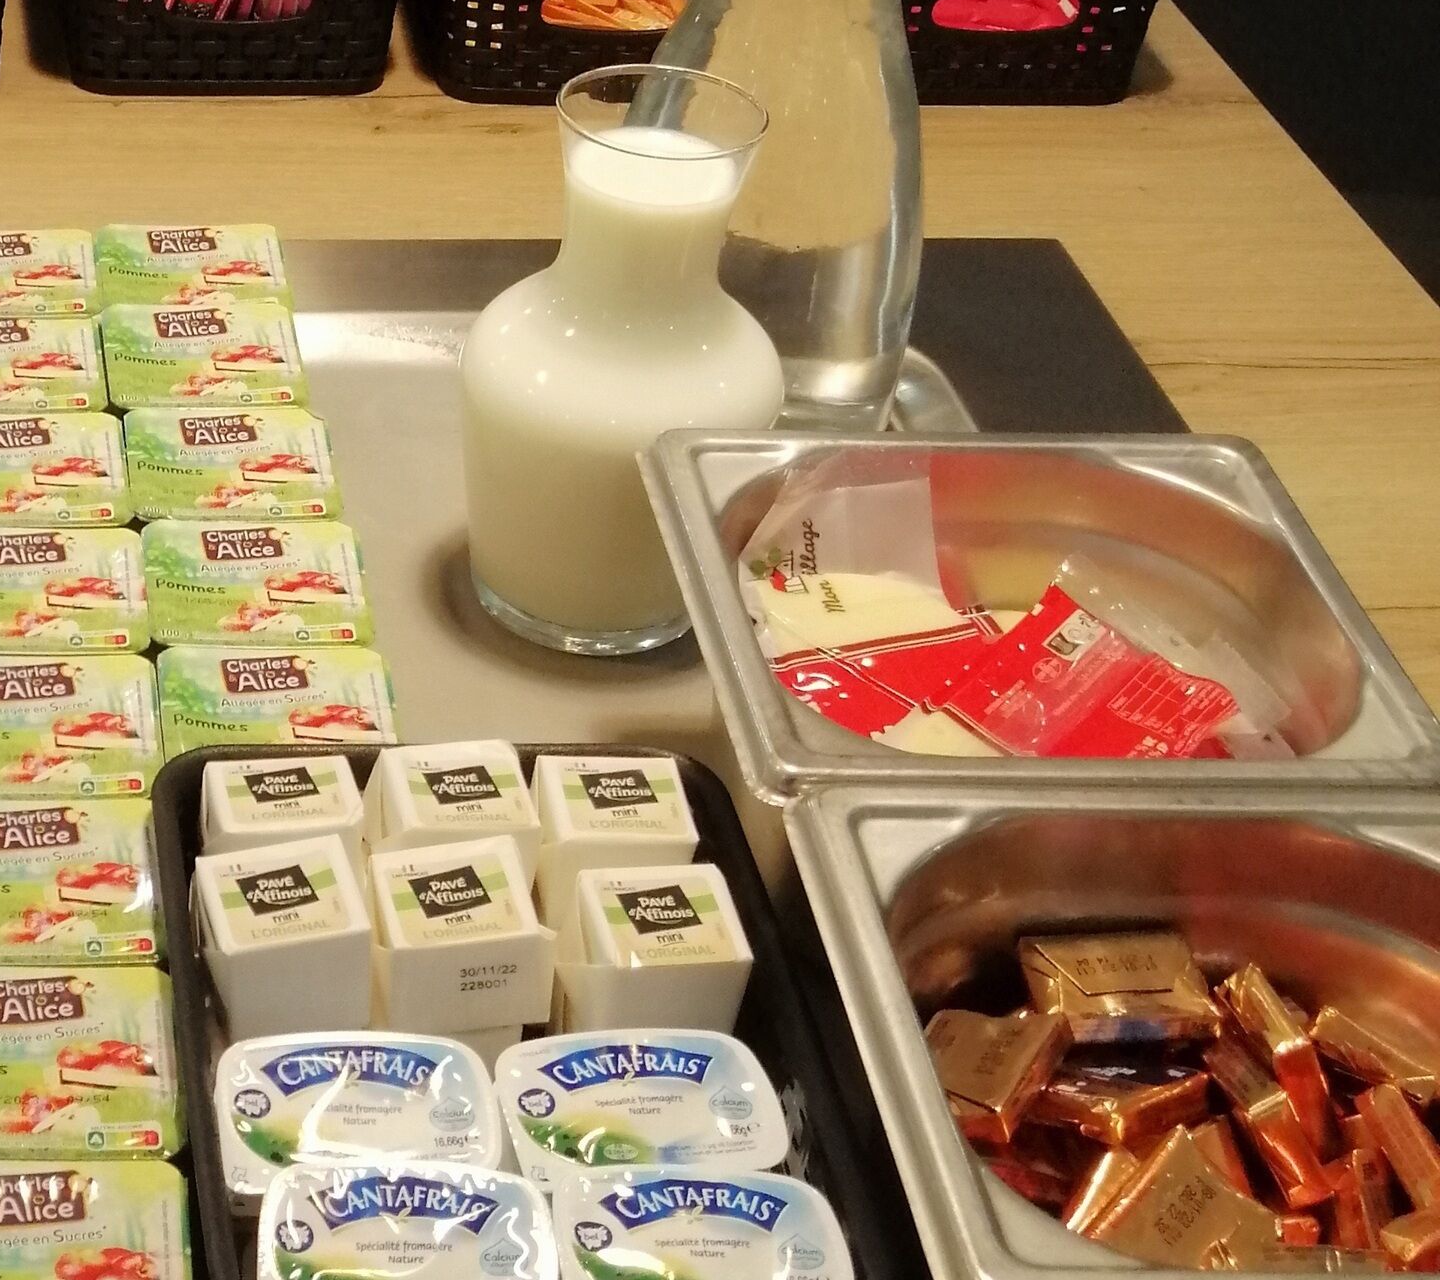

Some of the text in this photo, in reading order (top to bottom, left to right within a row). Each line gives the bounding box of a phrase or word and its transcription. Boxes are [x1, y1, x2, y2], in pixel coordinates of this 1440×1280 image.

[149, 229, 203, 241] Charles
[161, 239, 211, 253] Alice
[206, 530, 266, 542] Charles
[0, 547, 58, 563] Alice
[216, 542, 274, 559] Alice
[155, 578, 226, 595] Pommes
[225, 659, 291, 673] Charles
[238, 672, 299, 690] Alice
[4, 681, 66, 698] Alice
[174, 713, 248, 733] Pommes
[264, 774, 298, 784] PAVÉ
[443, 773, 479, 783] PAVÉ
[599, 777, 635, 787] PAVÉ
[274, 800, 300, 809] mini
[456, 803, 483, 811] mini
[612, 808, 638, 817] mini
[4, 826, 70, 847] Alice
[258, 877, 293, 888] PAVÉ
[430, 877, 466, 890] PAVÉ
[638, 896, 675, 908] PAVÉ
[272, 911, 300, 924] mini
[445, 914, 472, 925] mini
[657, 933, 683, 943] mini
[460, 964, 517, 978] 30/11/22
[2, 997, 73, 1019] Alice
[553, 1052, 700, 1084] CANTAFRAIS
[616, 1188, 775, 1222] CANTAFRAIS
[32, 1235, 48, 1243] en
[388, 1254, 423, 1264] Nature
